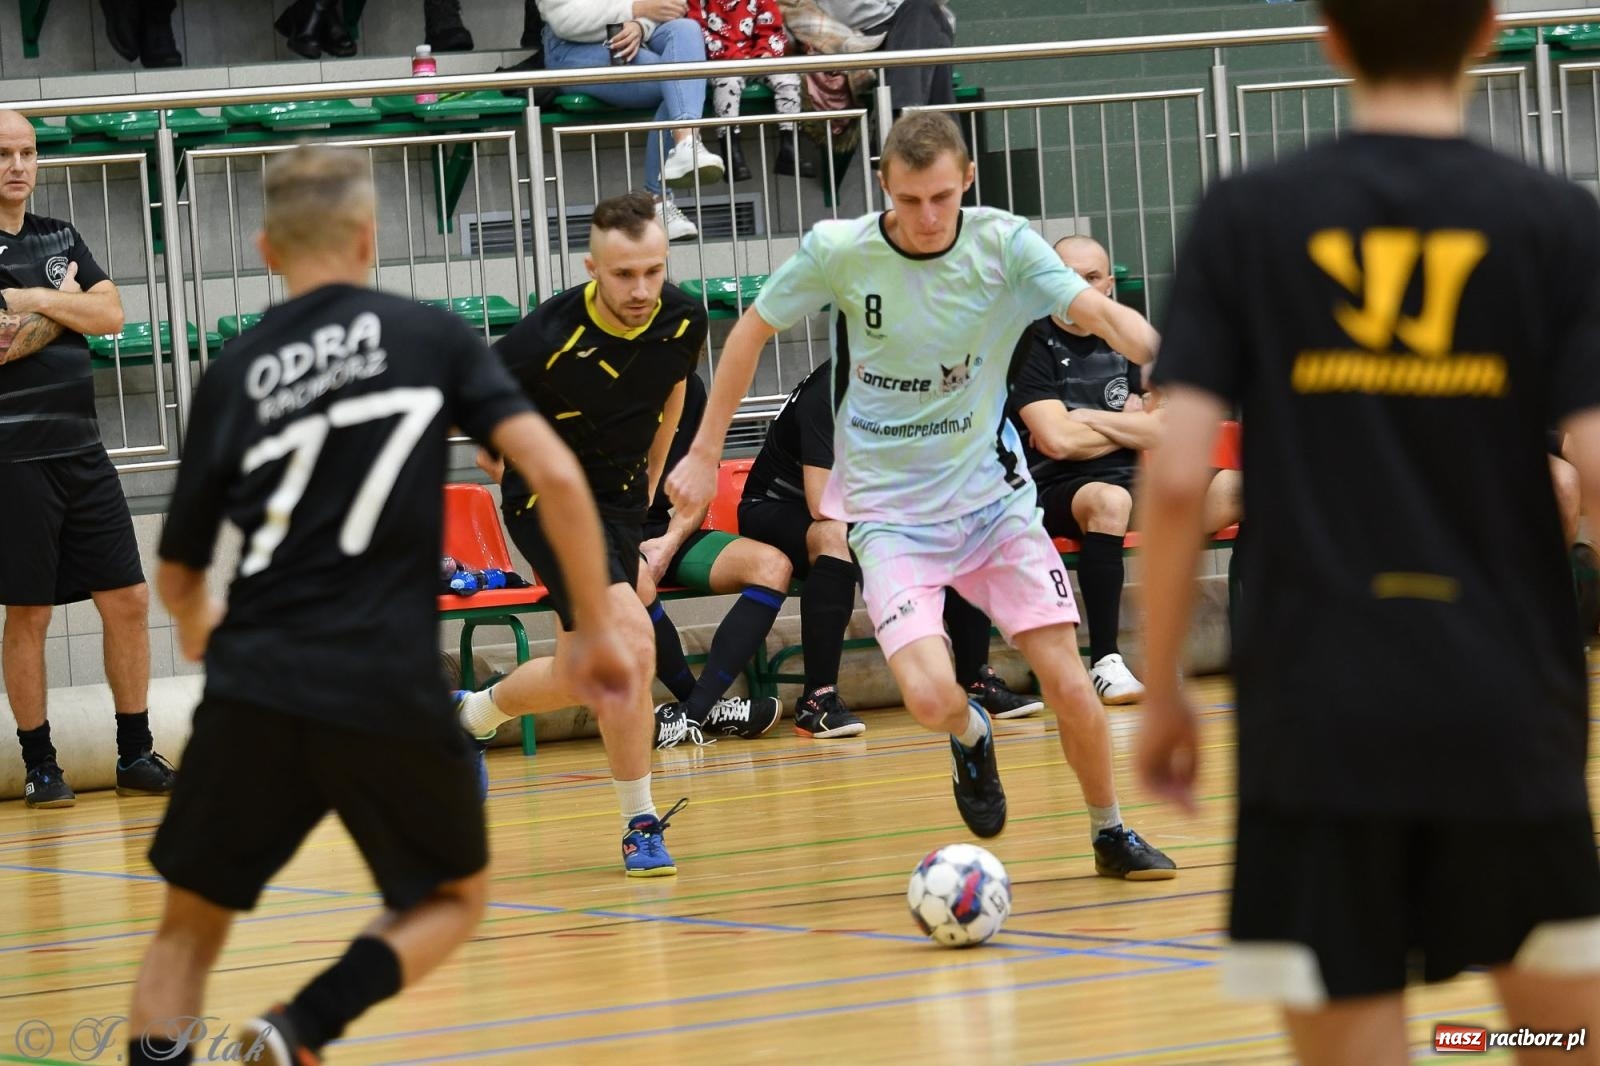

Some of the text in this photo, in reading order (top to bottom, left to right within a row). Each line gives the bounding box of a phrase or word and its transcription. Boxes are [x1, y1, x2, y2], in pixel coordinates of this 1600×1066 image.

[865, 294, 882, 329] 8
[245, 311, 383, 400] ODRA
[856, 364, 932, 393] Concrete
[241, 386, 445, 578] 77
[1049, 569, 1068, 598] 8
